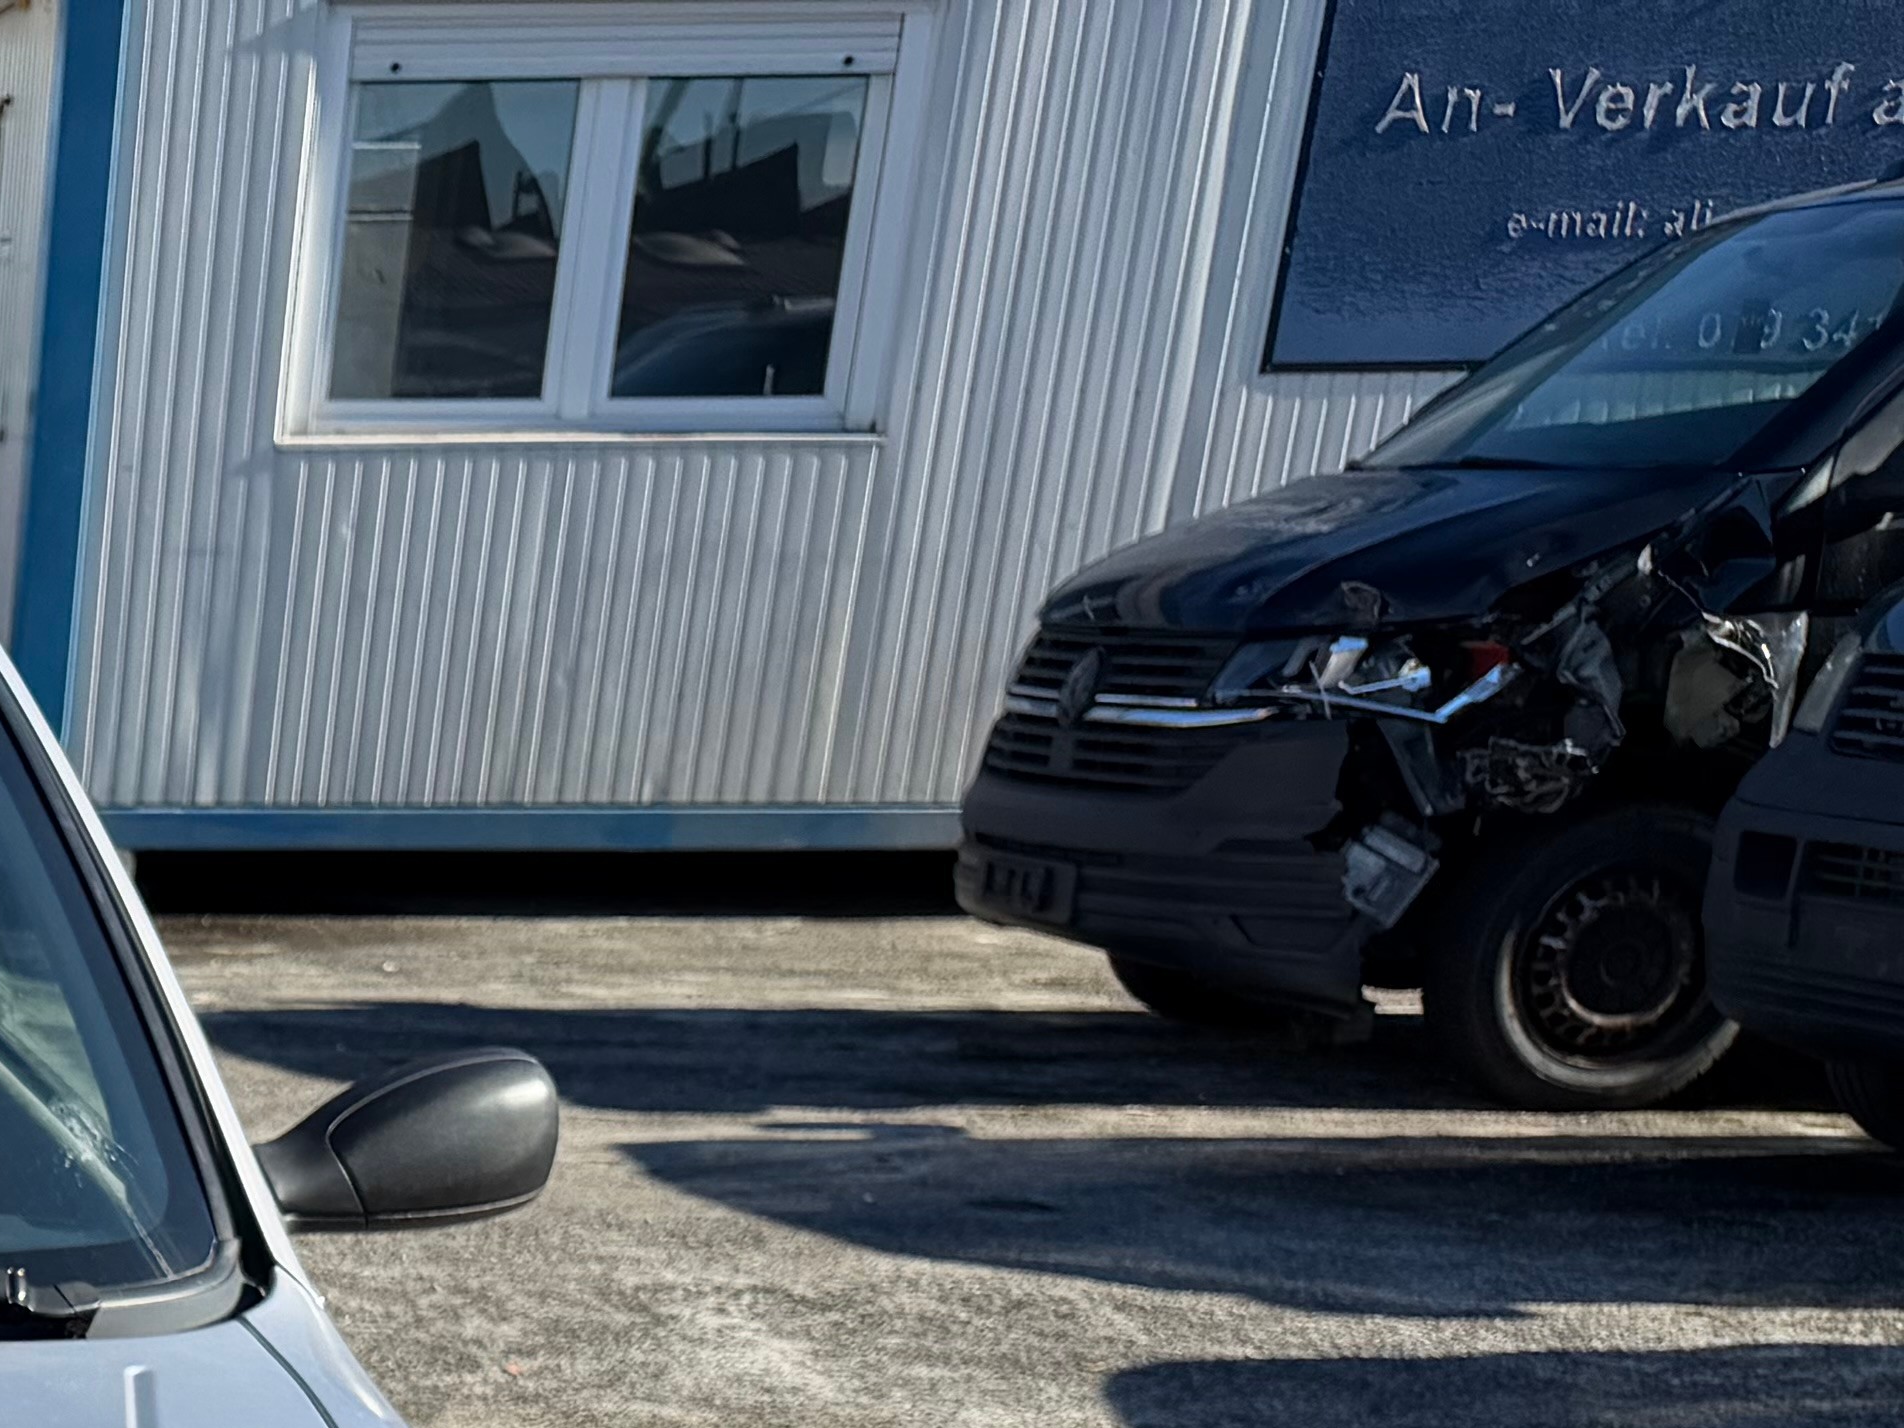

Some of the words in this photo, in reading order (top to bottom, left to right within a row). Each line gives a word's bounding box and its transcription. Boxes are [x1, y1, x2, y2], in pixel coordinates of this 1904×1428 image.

[1375, 72, 1516, 134] An-
[1548, 61, 1856, 130] Verkauf
[1507, 200, 1648, 239] e-mail:
